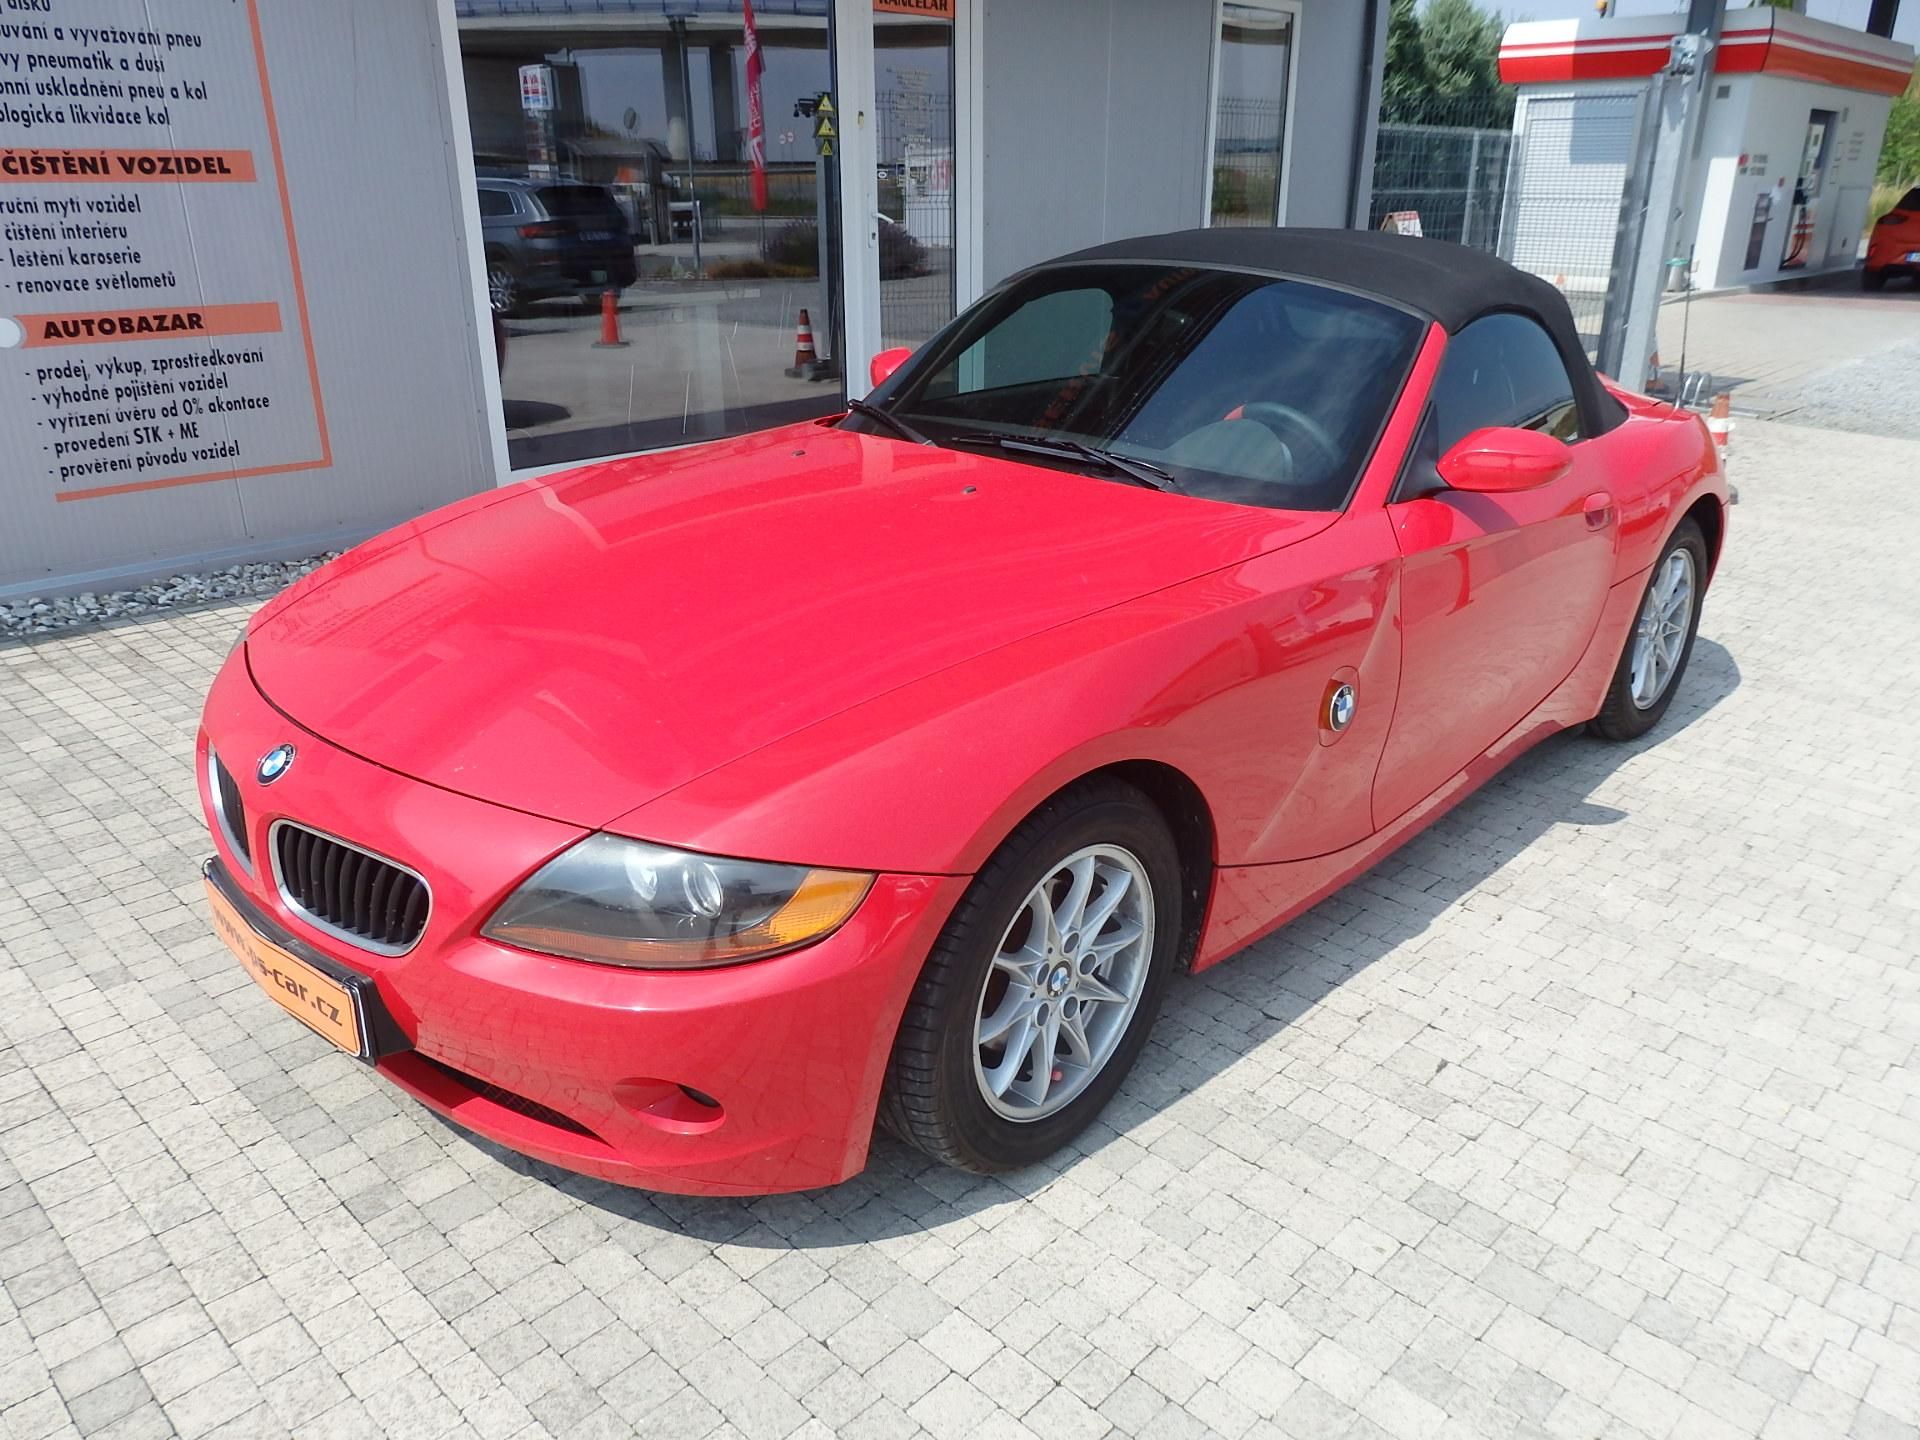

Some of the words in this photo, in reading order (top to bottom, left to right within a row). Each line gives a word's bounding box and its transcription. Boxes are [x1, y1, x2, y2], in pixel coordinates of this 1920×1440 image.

[0, 21, 48, 40] uvání
[54, 27, 64, 41] a
[69, 26, 161, 47] vyvažování
[166, 33, 202, 51] pneu
[26, 50, 114, 73] pneumatik
[120, 58, 129, 71] a
[36, 76, 123, 98] uskladnění
[128, 85, 165, 103] pneu
[170, 86, 179, 99] a
[183, 80, 208, 100] kol
[69, 103, 142, 125] likvidace
[145, 105, 170, 126] kol
[2, 149, 110, 175] ČIŠTĚNÍ
[117, 156, 231, 175] VOZIDEL
[0, 196, 39, 214] ruční
[44, 196, 81, 219] mytí
[86, 193, 141, 214] vozidel
[5, 221, 56, 241] čištění
[9, 247, 65, 268] leštění
[68, 246, 142, 266] karoserie
[17, 278, 90, 293] renovace
[96, 270, 176, 290] světlometů
[44, 313, 204, 339] AUTOBAZAR
[37, 359, 91, 385] prodej,
[95, 356, 147, 380] výkup,
[151, 347, 264, 375] zprostředkování
[42, 383, 109, 409] výhodné
[114, 379, 175, 403] pojištění
[179, 372, 229, 392] vozidel
[48, 408, 111, 434] vyřízení
[115, 406, 156, 423] úvěru
[161, 400, 179, 418] od
[182, 398, 204, 416] 0%
[208, 396, 270, 413] akontace
[54, 431, 130, 459] provedení
[133, 425, 163, 444] STK
[168, 428, 175, 439] +
[179, 421, 200, 440] ME
[60, 454, 132, 482] prověření
[136, 447, 187, 472] původu
[192, 439, 241, 461] vozidel
